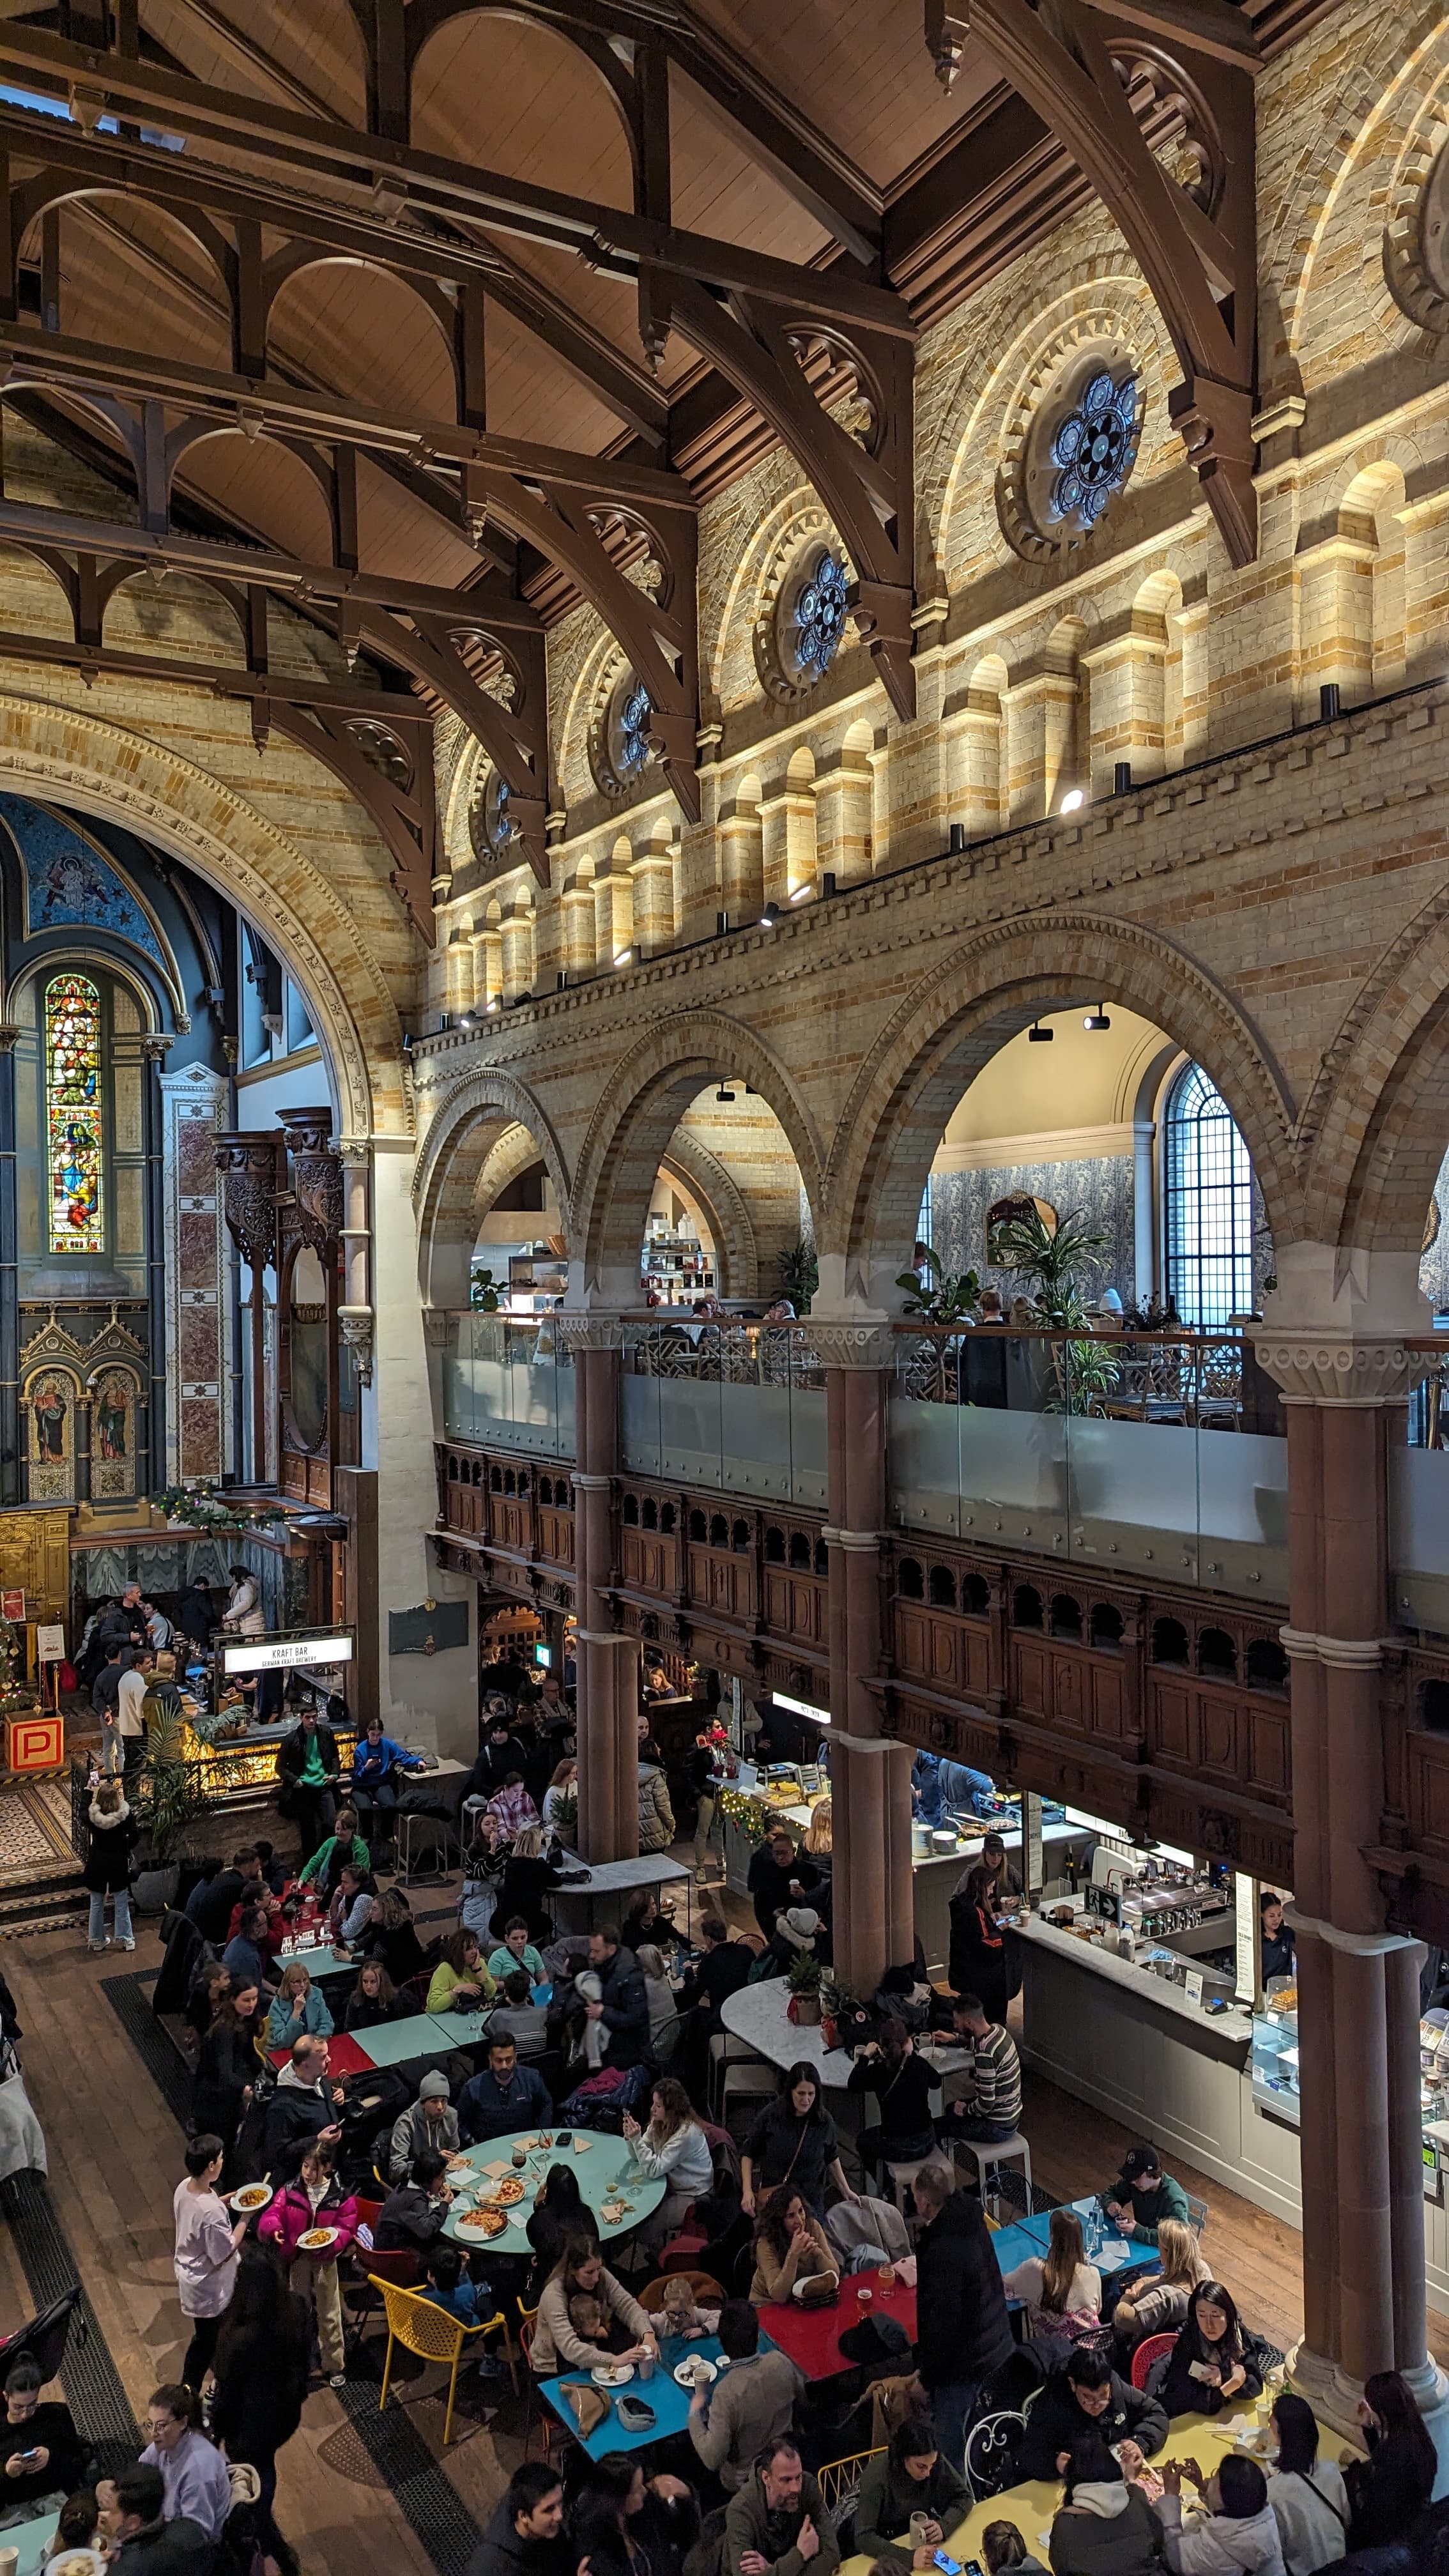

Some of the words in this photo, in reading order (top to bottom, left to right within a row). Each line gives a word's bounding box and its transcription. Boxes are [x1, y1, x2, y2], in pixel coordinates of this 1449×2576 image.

[272, 1647, 293, 1659] KRAFT
[295, 1646, 308, 1657] BAR
[262, 1659, 280, 1667] GERMAN
[24, 1731, 50, 1759] P
